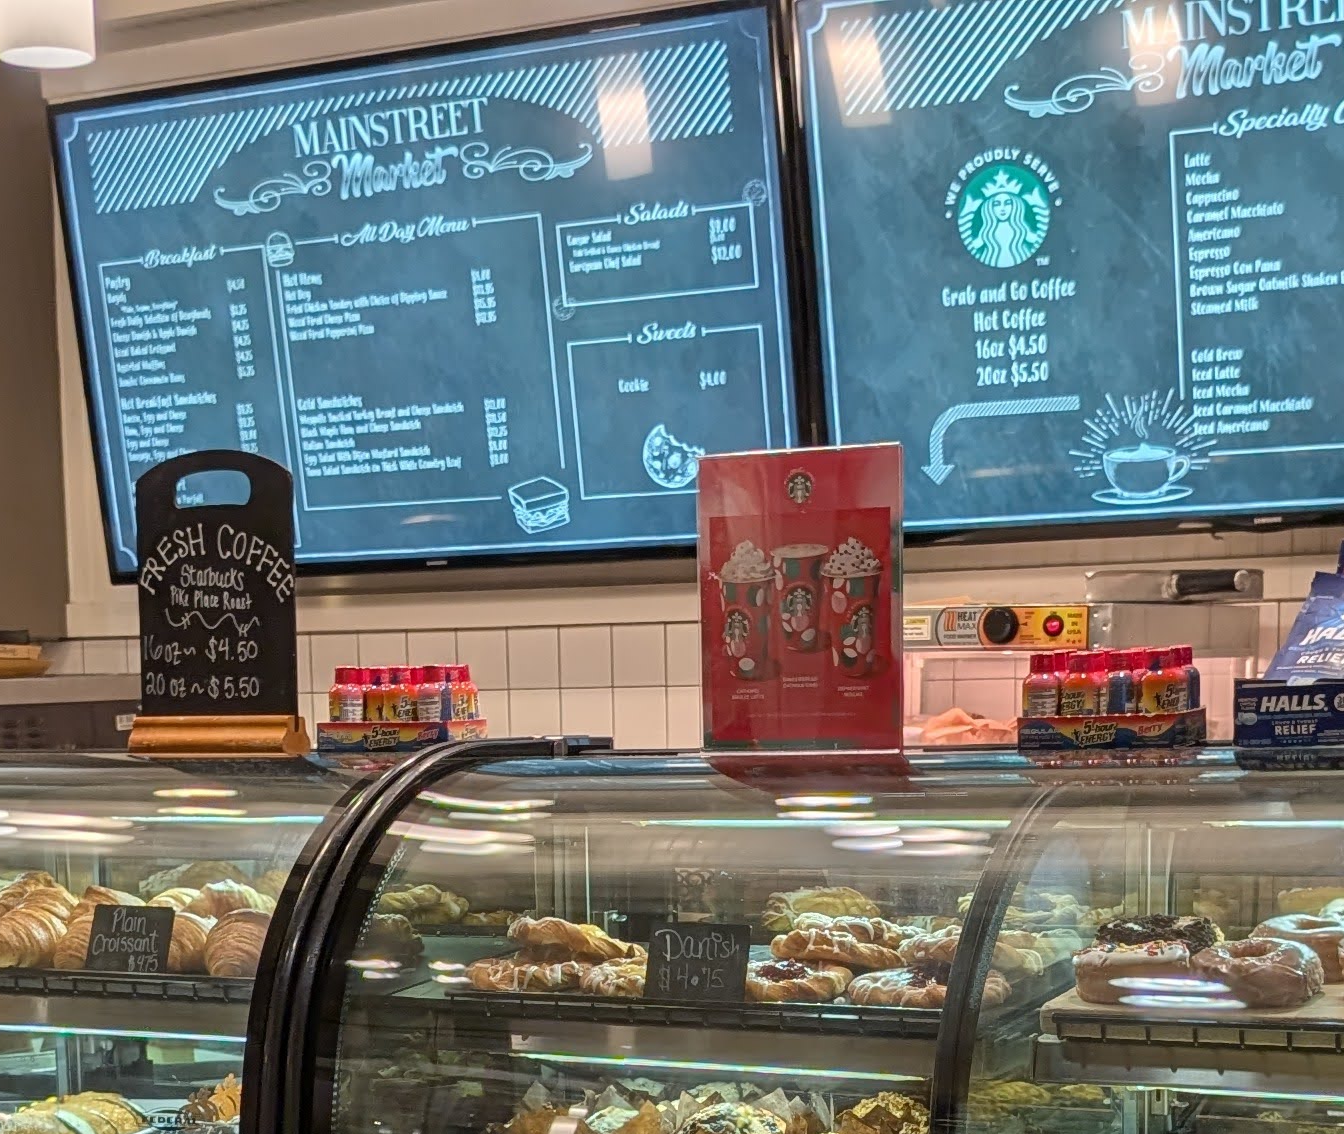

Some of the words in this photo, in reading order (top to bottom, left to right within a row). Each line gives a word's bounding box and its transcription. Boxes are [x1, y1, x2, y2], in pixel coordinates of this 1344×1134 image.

[1167, 34, 1342, 98] Market
[292, 97, 489, 158] MAINSTREET
[1220, 105, 1331, 138] Specialty
[1184, 153, 1211, 168] Latte
[330, 146, 459, 200] Market
[945, 180, 961, 205] WE
[958, 148, 1021, 180] PROUDLY
[1023, 152, 1059, 193] SERVE
[1185, 171, 1220, 187] Mocha
[624, 200, 689, 225] Salads
[1187, 206, 1229, 224] Caramel
[1230, 201, 1286, 219] Macchiato
[340, 224, 377, 246] All
[378, 221, 415, 244] Day
[416, 215, 470, 238] Menu
[1188, 227, 1241, 243] Americano
[143, 245, 217, 269] Breakfast
[1189, 247, 1231, 262] Espresso
[1189, 265, 1230, 281] Espresso
[1190, 283, 1223, 297] Brown
[1226, 281, 1256, 296] Sugar
[1259, 275, 1300, 292] Oatmilk
[1301, 273, 1338, 287] Shaken
[942, 284, 976, 307] Grab
[980, 281, 1006, 303] and
[1010, 280, 1028, 300] Go
[1032, 276, 1077, 301] Coffee
[1191, 299, 1233, 316] Steamed
[1234, 297, 1259, 311] Milk
[974, 310, 999, 332] Hot
[1002, 306, 1047, 331] Coffee
[637, 321, 697, 344] Sweets
[975, 338, 1005, 359] 16oz
[1008, 333, 1048, 360] $4.50
[1191, 349, 1214, 363] Cold
[1216, 347, 1244, 362] Brew
[976, 365, 1007, 386] 20oz
[1011, 361, 1048, 387] $5.50
[1192, 367, 1213, 381] Iced
[1215, 366, 1241, 380] Latte
[618, 379, 649, 393] Cookie
[1193, 386, 1213, 400] Iced
[1215, 384, 1250, 399] Mocha
[1193, 404, 1214, 417] Iced
[1216, 400, 1257, 415] Caramel
[1259, 397, 1314, 413] Macchiato
[1217, 419, 1270, 434] Americano
[140, 523, 206, 595] FRESH
[217, 524, 294, 602] COFFEE
[180, 564, 245, 591] Starbucks
[170, 586, 190, 607] Pike
[194, 591, 219, 608] Place
[223, 591, 252, 610] Roast
[206, 636, 258, 662] $4.50
[146, 672, 165, 695] 20
[1081, 731, 1115, 746] ENERGY
[1138, 723, 1163, 736] Berry
[1274, 724, 1317, 736] RELIEF
[112, 907, 146, 935] Plain
[92, 930, 159, 955] Croissant
[655, 929, 740, 962] Danish
